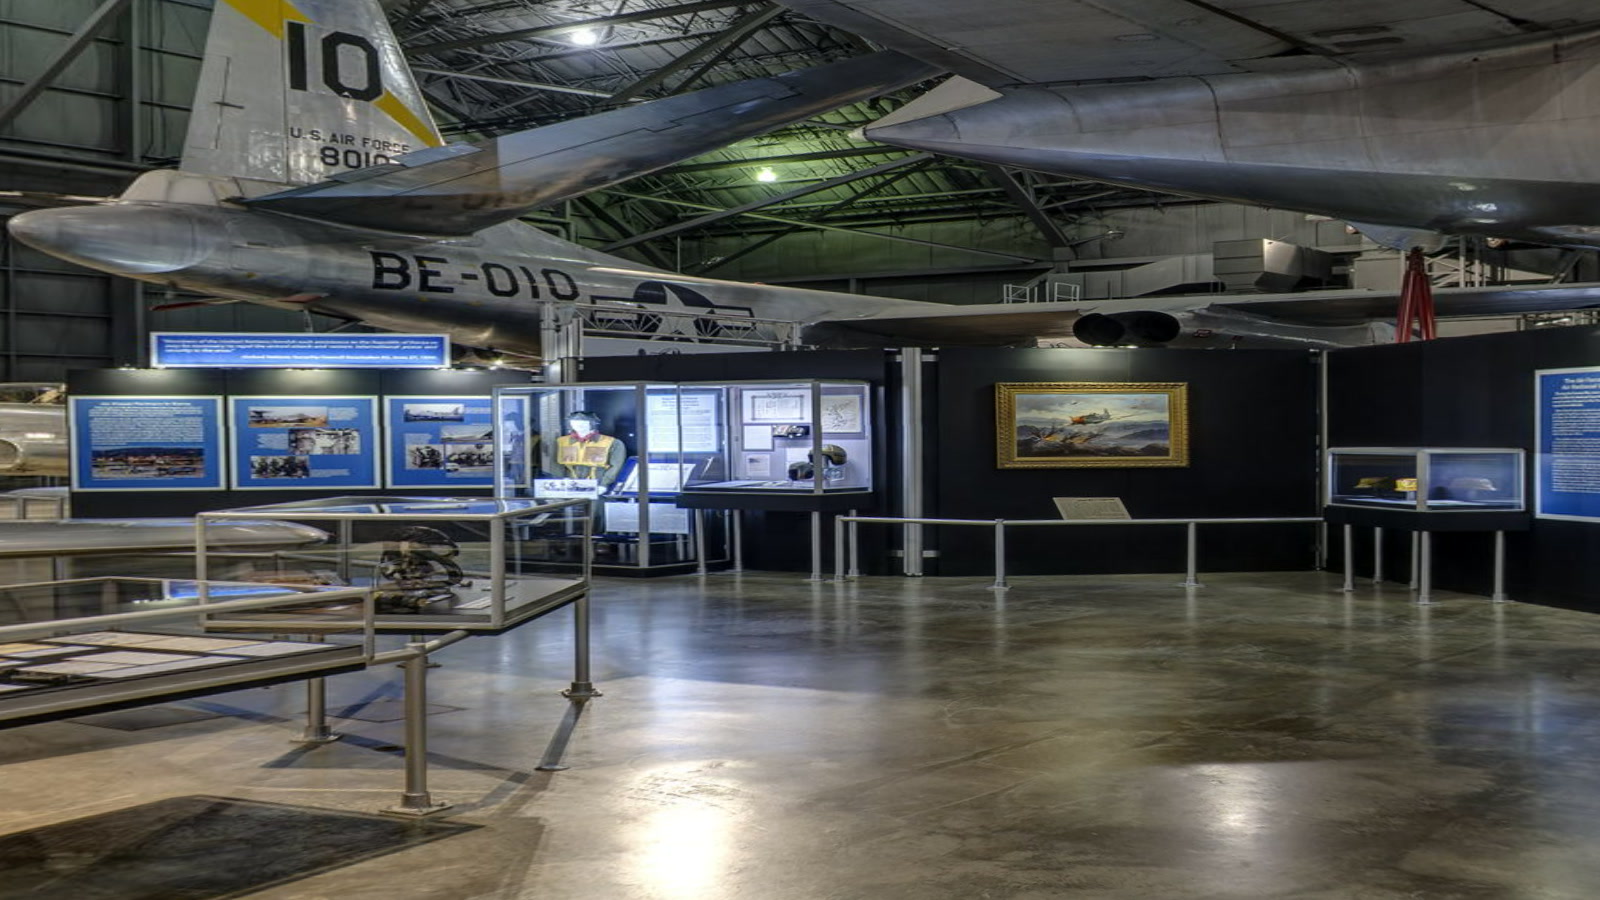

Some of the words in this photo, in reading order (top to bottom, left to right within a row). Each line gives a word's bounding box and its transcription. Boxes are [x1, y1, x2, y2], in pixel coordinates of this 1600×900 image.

[287, 21, 383, 102] 10
[290, 127, 325, 142] U.S.
[329, 133, 355, 146] AIR
[362, 137, 410, 156] FORCE
[370, 251, 580, 301] BE-010
